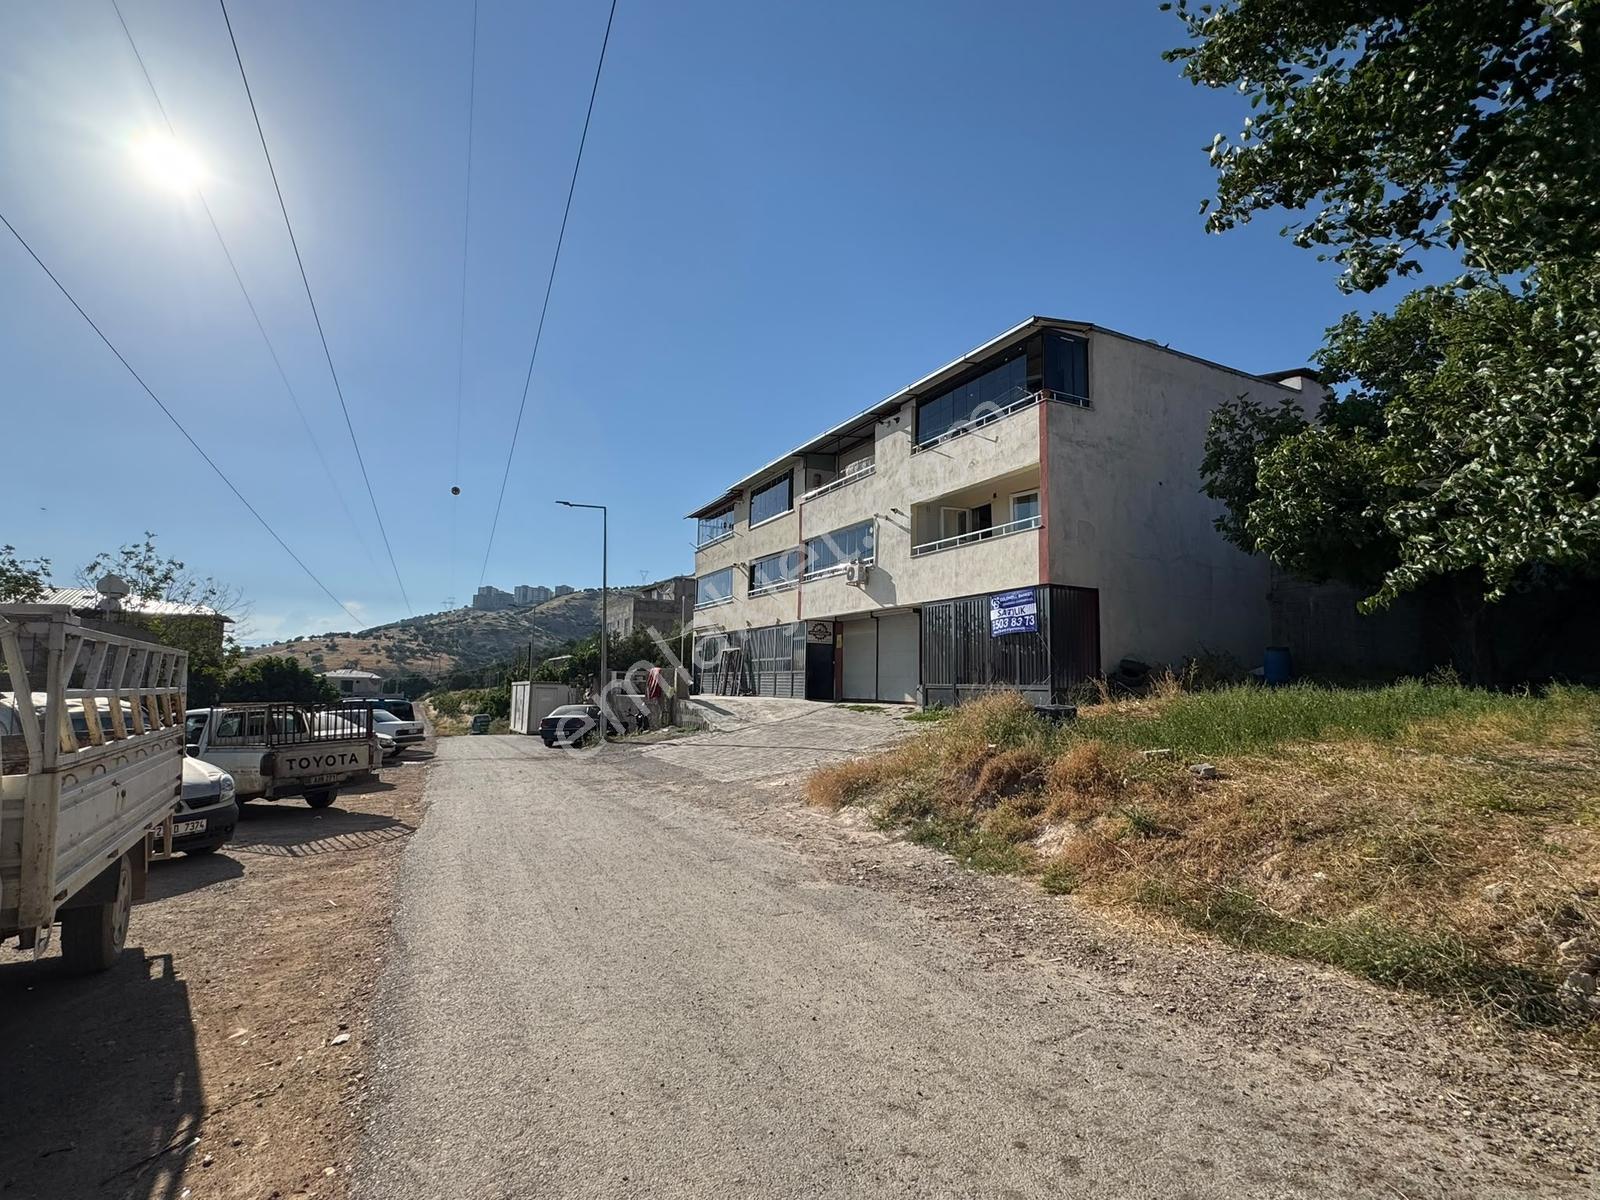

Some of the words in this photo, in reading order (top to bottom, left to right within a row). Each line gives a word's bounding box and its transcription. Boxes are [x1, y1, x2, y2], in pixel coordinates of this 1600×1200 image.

[997, 606, 1026, 617] SATILIK
[995, 618, 1009, 629] 503
[1011, 617, 1023, 627] 83
[1024, 615, 1035, 626] 73
[285, 753, 359, 771] TOYOTA
[184, 821, 204, 832] 7374
